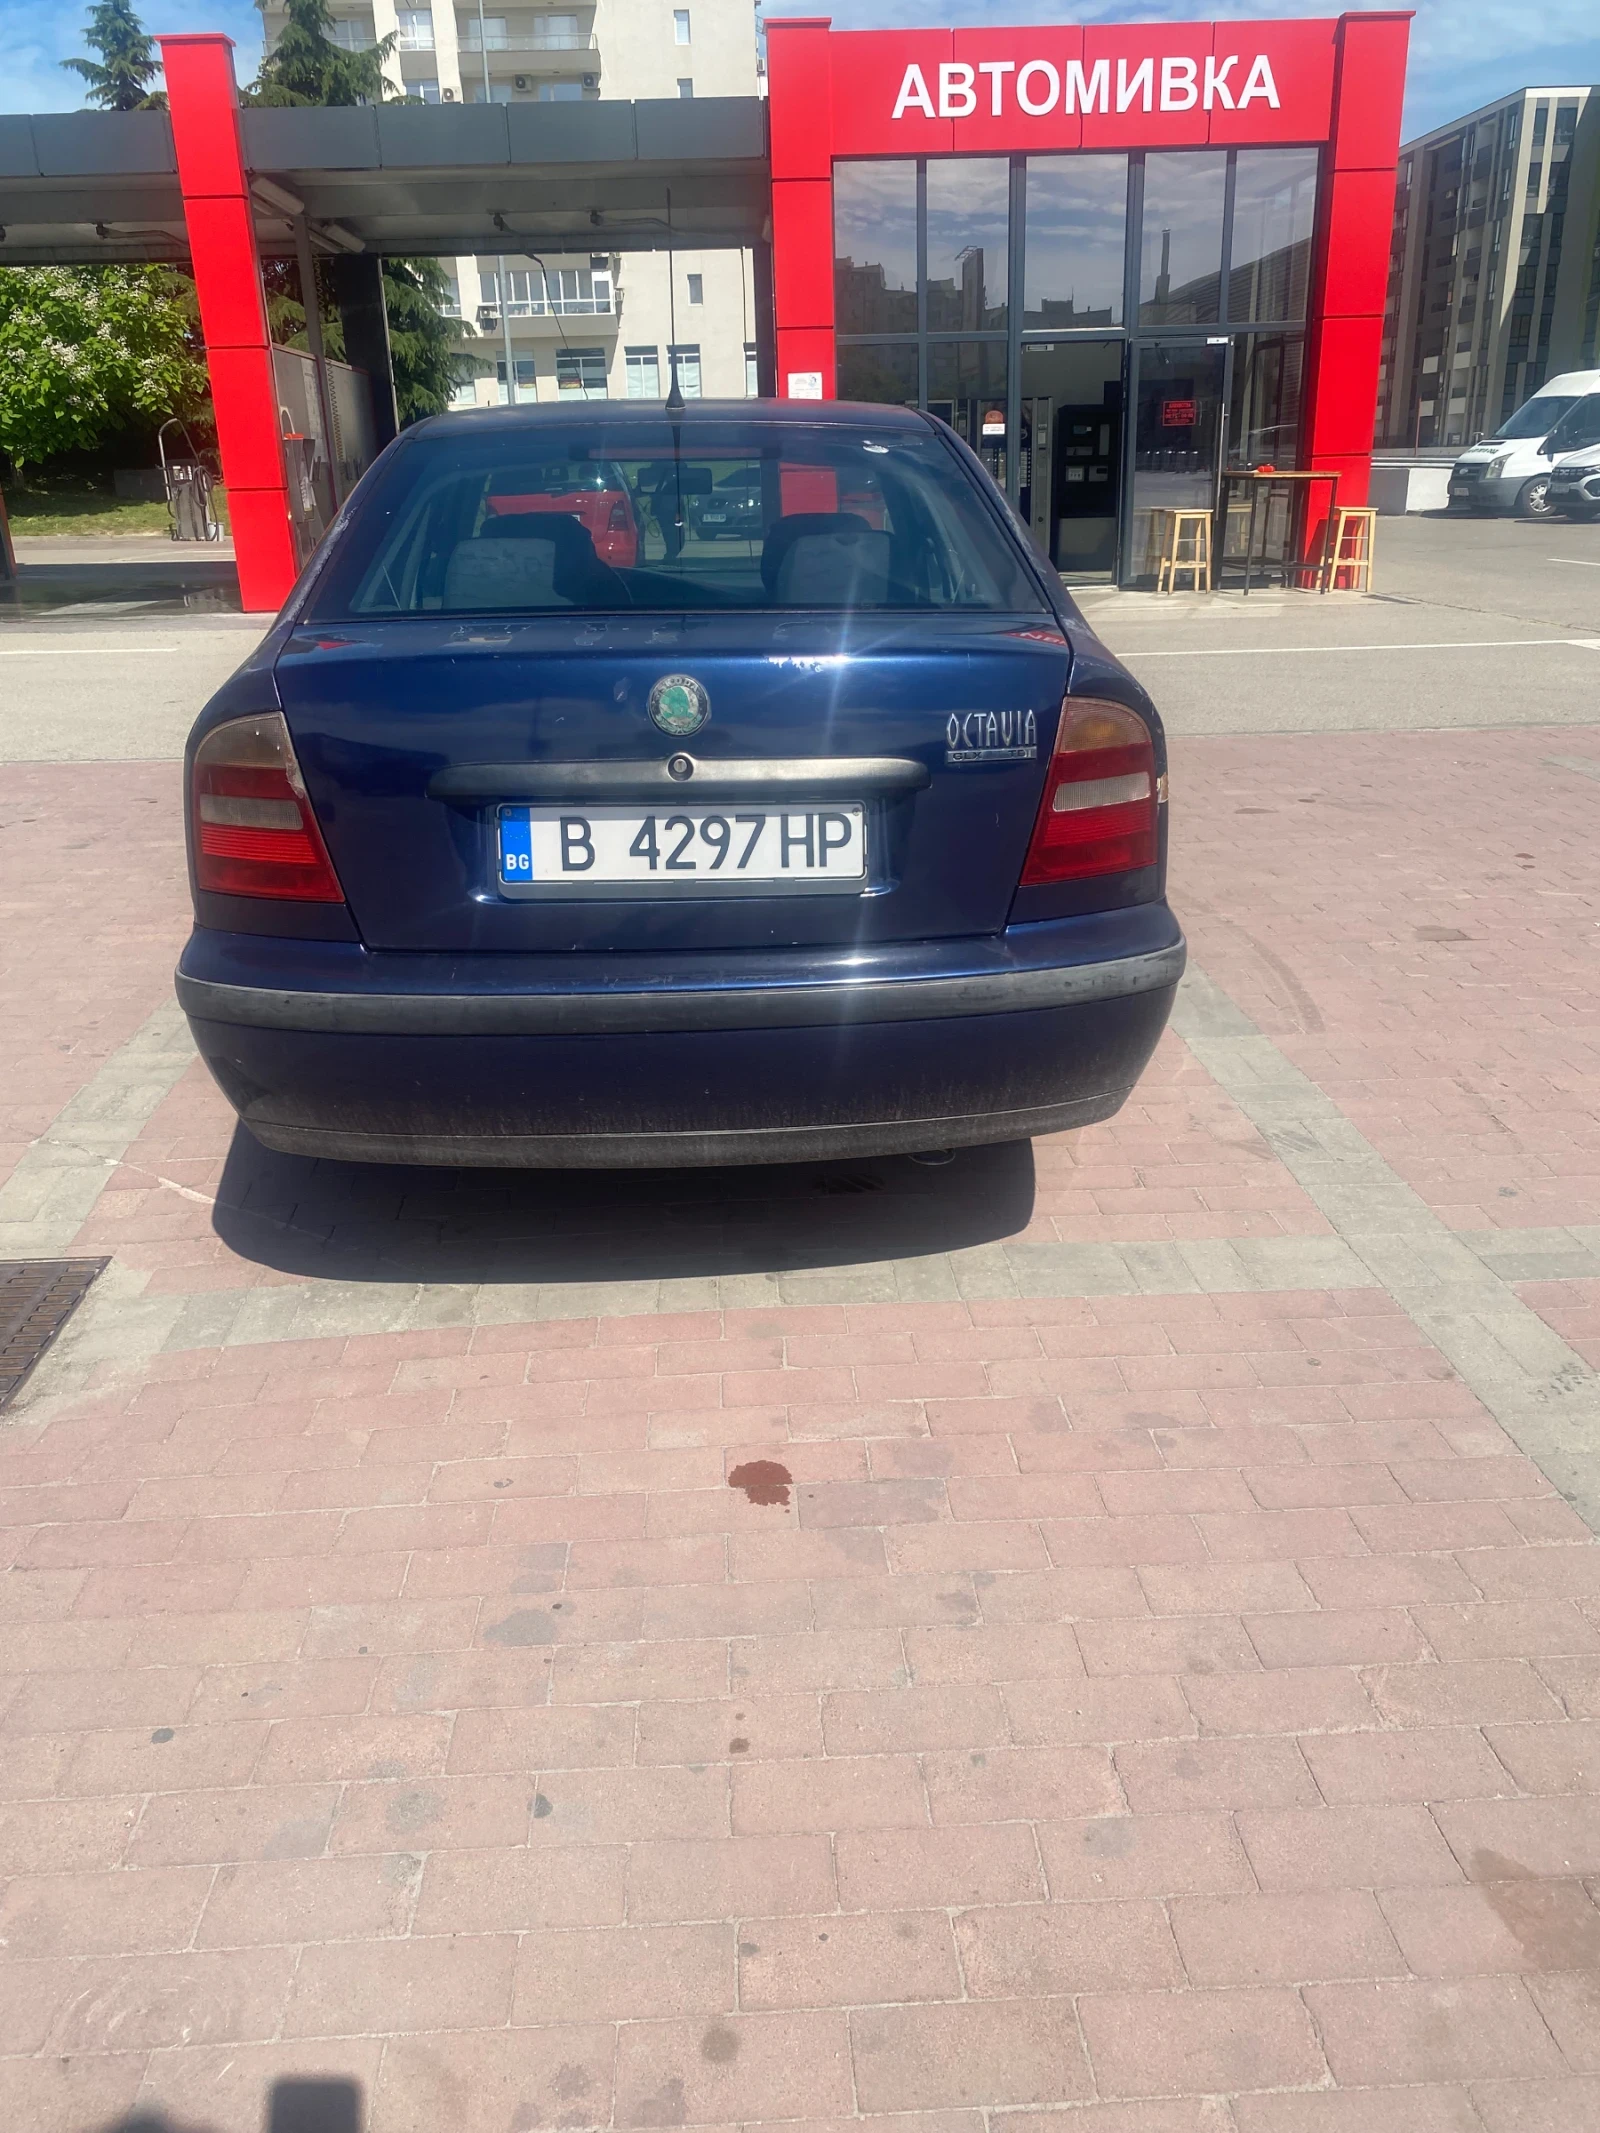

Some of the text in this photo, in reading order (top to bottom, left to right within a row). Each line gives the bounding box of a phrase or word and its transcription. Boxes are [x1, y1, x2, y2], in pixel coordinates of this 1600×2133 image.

[891, 54, 1281, 119] АВТОМИВКА
[946, 709, 1037, 749] OCTAVIA
[952, 748, 1033, 761] GLX TDI
[506, 853, 530, 870] BG
[559, 812, 853, 872] B 4297 HP
